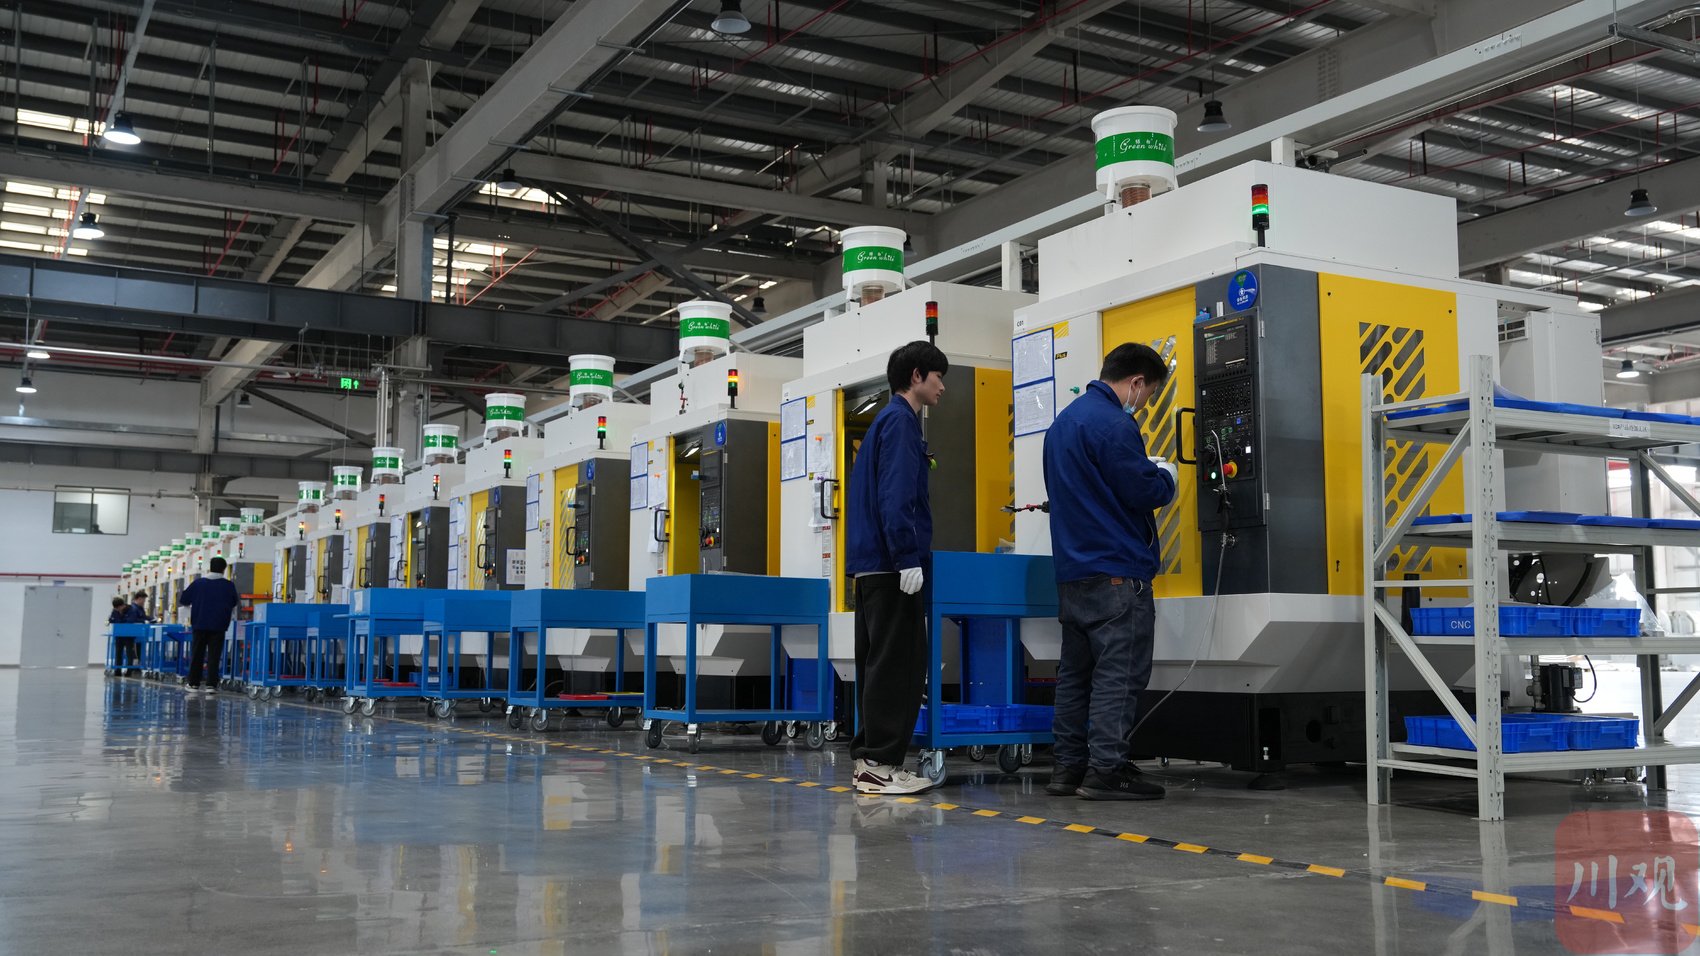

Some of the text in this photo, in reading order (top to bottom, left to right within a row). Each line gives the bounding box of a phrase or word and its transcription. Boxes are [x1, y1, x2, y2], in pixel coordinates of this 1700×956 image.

[1120, 138, 1145, 153] Green
[857, 251, 877, 263] Green
[1450, 620, 1471, 629] CNC
